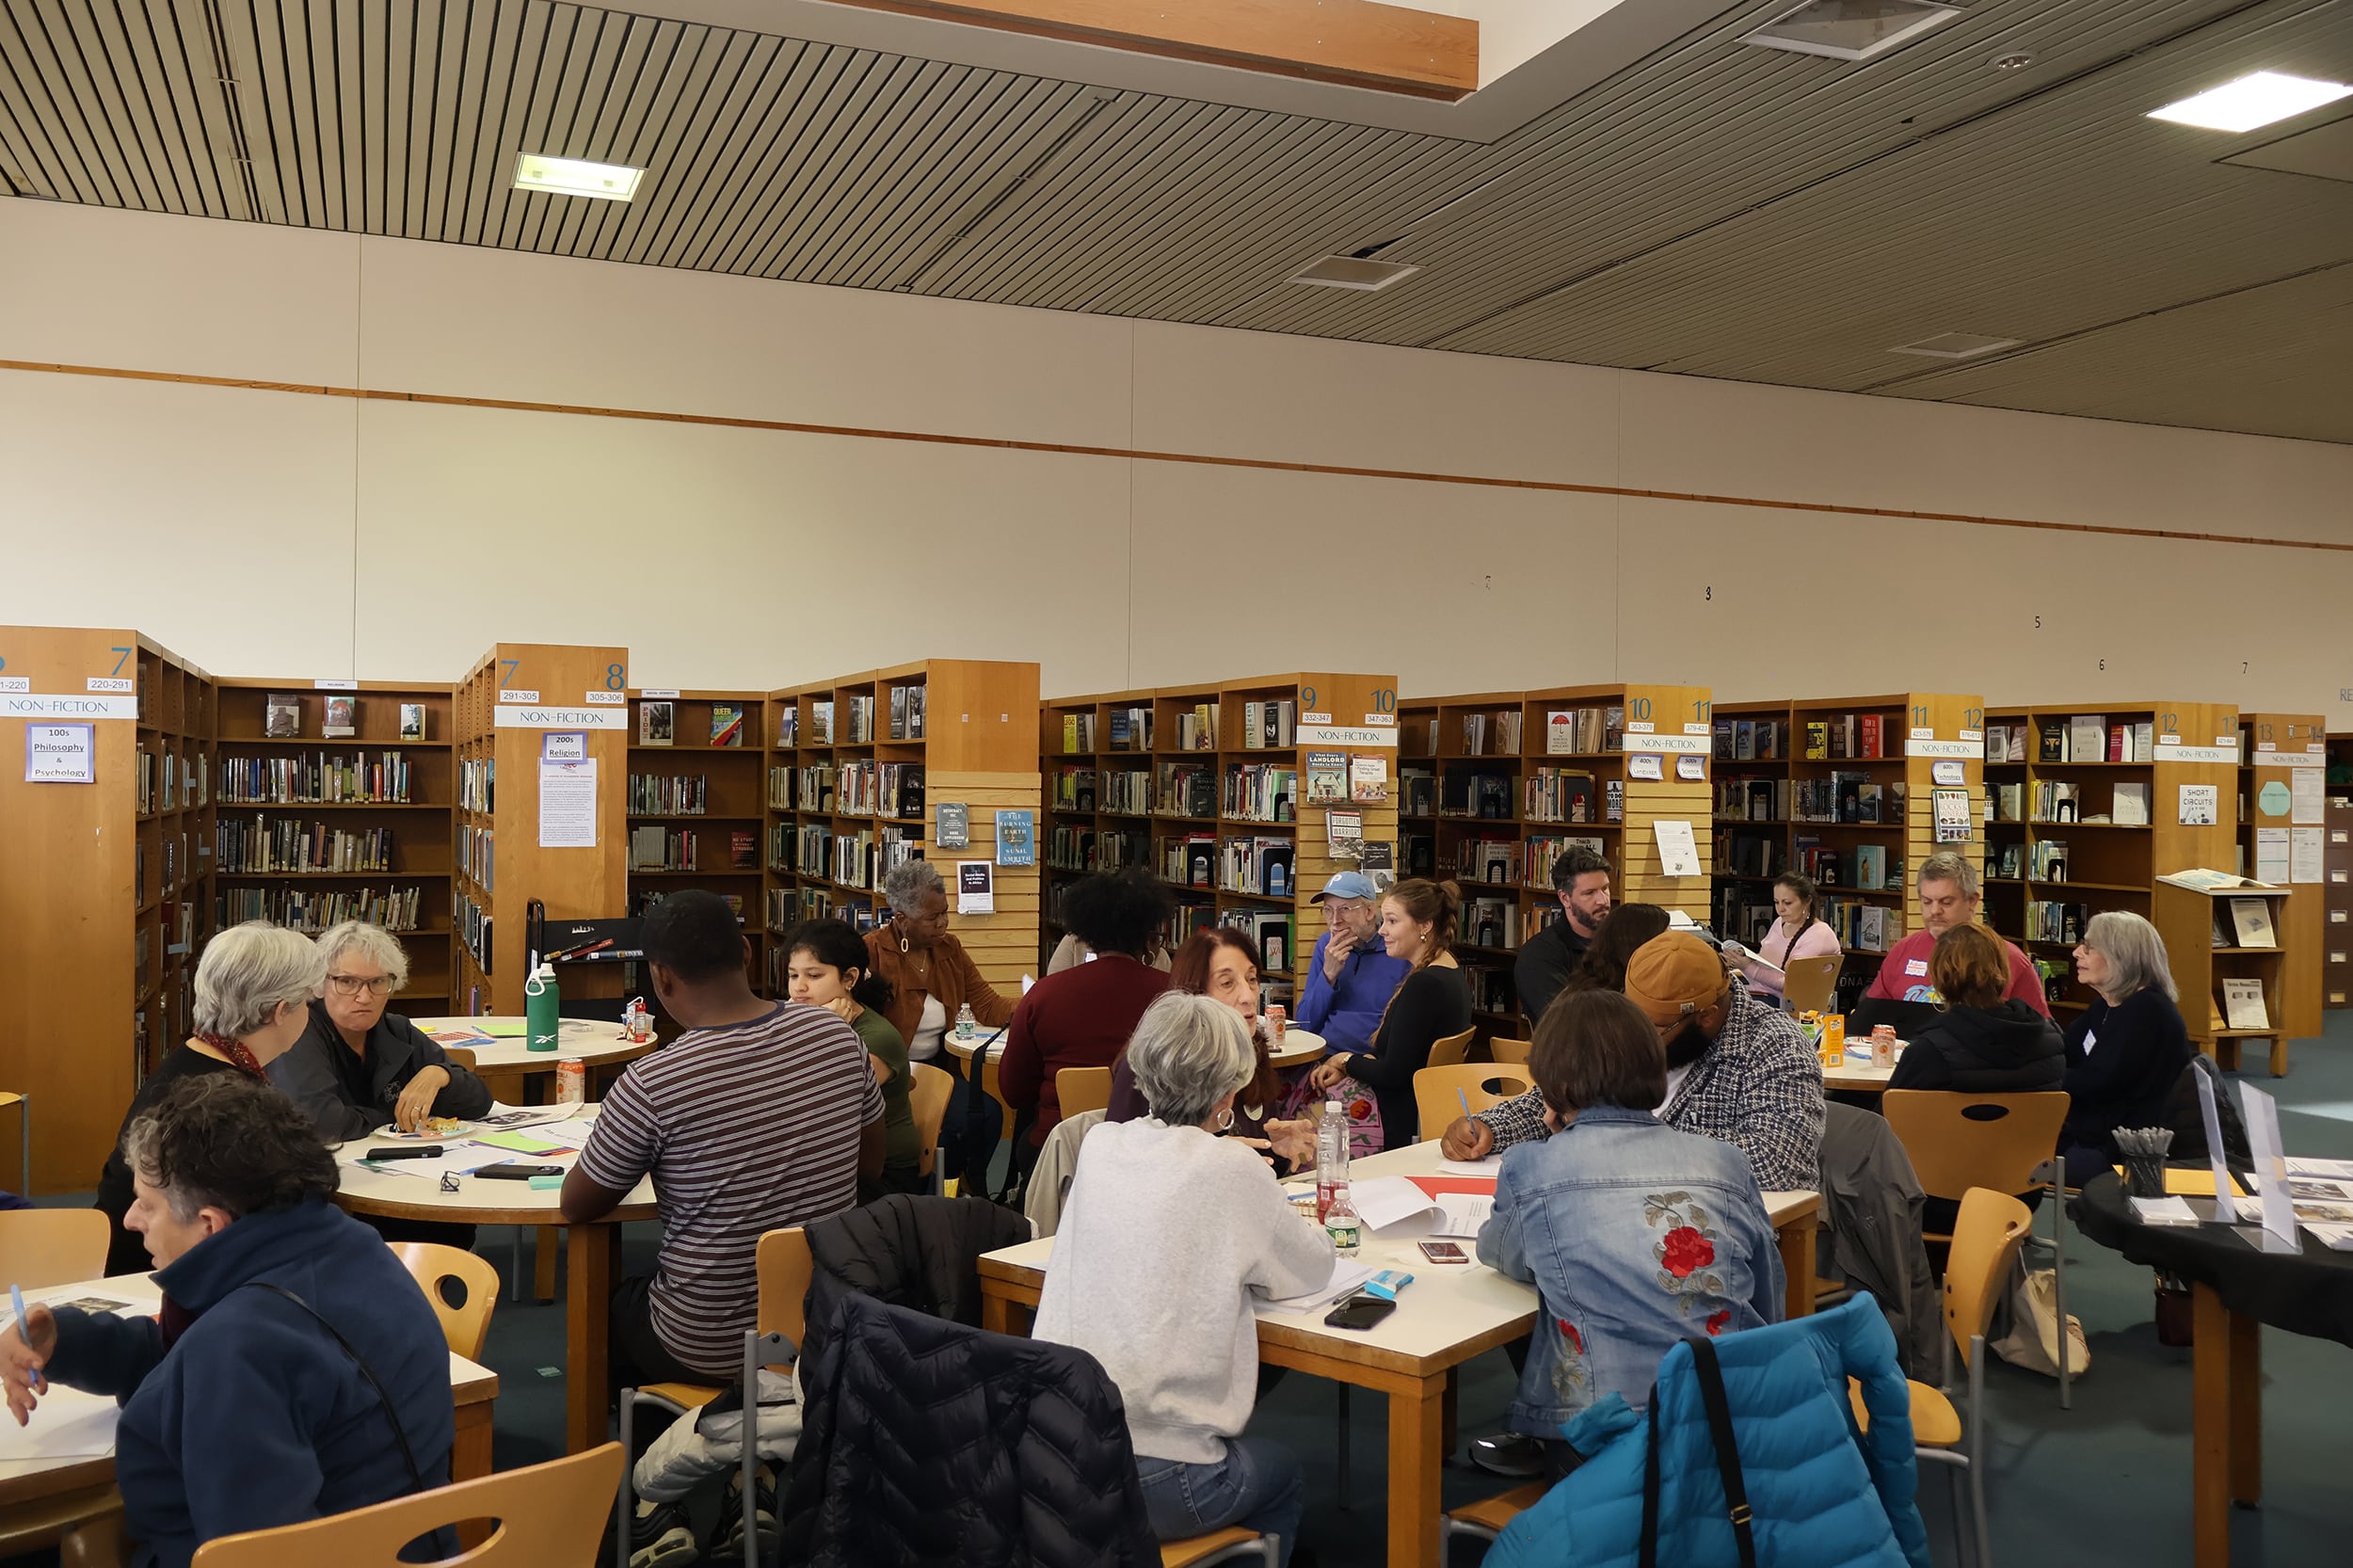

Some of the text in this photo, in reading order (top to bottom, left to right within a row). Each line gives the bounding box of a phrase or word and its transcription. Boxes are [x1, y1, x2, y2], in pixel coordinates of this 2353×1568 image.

[1705, 585, 1711, 600] 3
[2035, 616, 2041, 629] 5
[111, 647, 133, 676] 7
[2099, 659, 2105, 670] 6
[2243, 662, 2249, 674] 7
[500, 660, 520, 687] 7
[606, 664, 625, 690] 8
[91, 680, 129, 689] 220-291
[504, 692, 537, 700] 291-305
[1302, 686, 1316, 711] 9
[1370, 689, 1396, 712] 10
[8, 699, 108, 712] NON-FICTION
[1628, 697, 1652, 720] 10
[1692, 700, 1710, 722] 11
[520, 712, 603, 724] NON-FICTION
[1912, 706, 1928, 726] 11
[1963, 708, 1982, 728] 12
[2161, 713, 2178, 732] 12
[2222, 715, 2237, 734] 13
[1318, 731, 1379, 741] NON-FICTION
[2259, 723, 2273, 741] 13
[34, 744, 85, 752] Philosophy
[1641, 739, 1696, 748] NON-FICTION
[1922, 744, 1970, 753] NON-FICTION
[549, 749, 581, 758] Religion
[35, 769, 86, 777] Psychology
[1332, 816, 1360, 825] FORGOTTEN
[1334, 827, 1361, 836] WARRIORS
[1839, 977, 1864, 986] DNA
